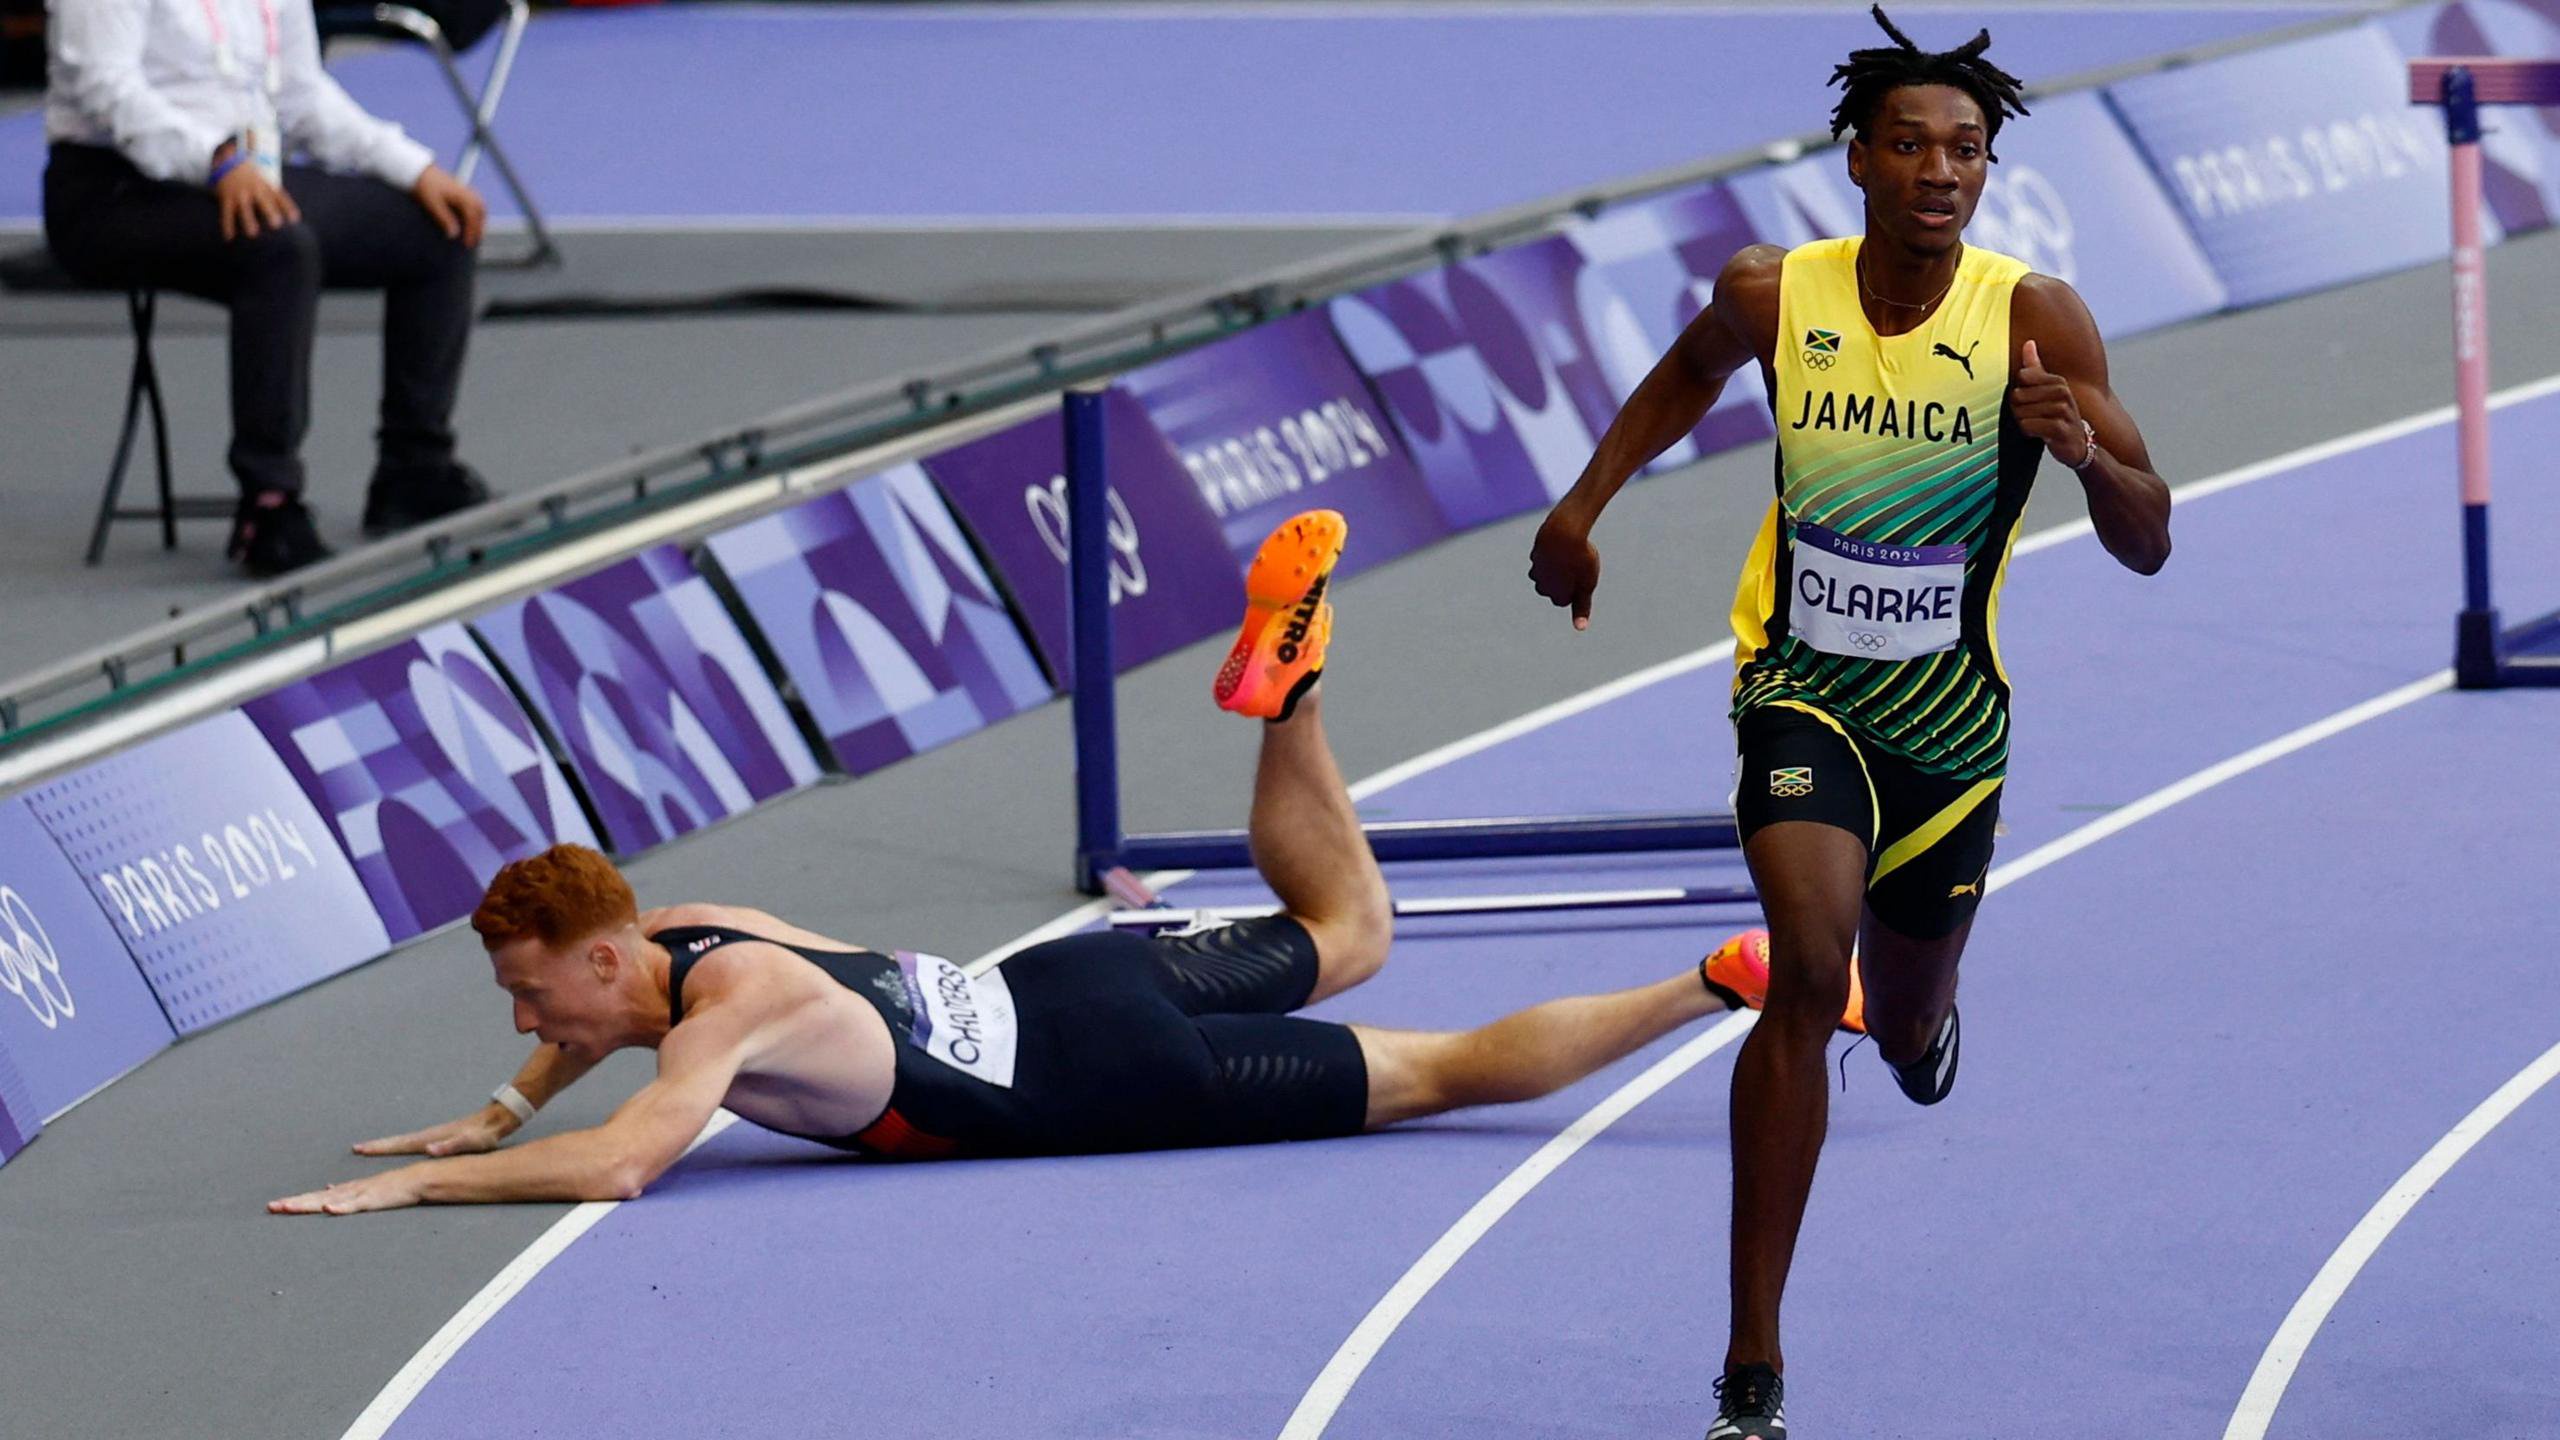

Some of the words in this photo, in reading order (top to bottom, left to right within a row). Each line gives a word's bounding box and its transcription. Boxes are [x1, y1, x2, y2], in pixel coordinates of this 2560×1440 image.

[1279, 397, 1390, 485] 2024
[1792, 390, 1973, 445] JAMAICA
[1880, 549, 1920, 561] 2024
[1798, 568, 1956, 623] CLARKE
[201, 807, 317, 899] 2024
